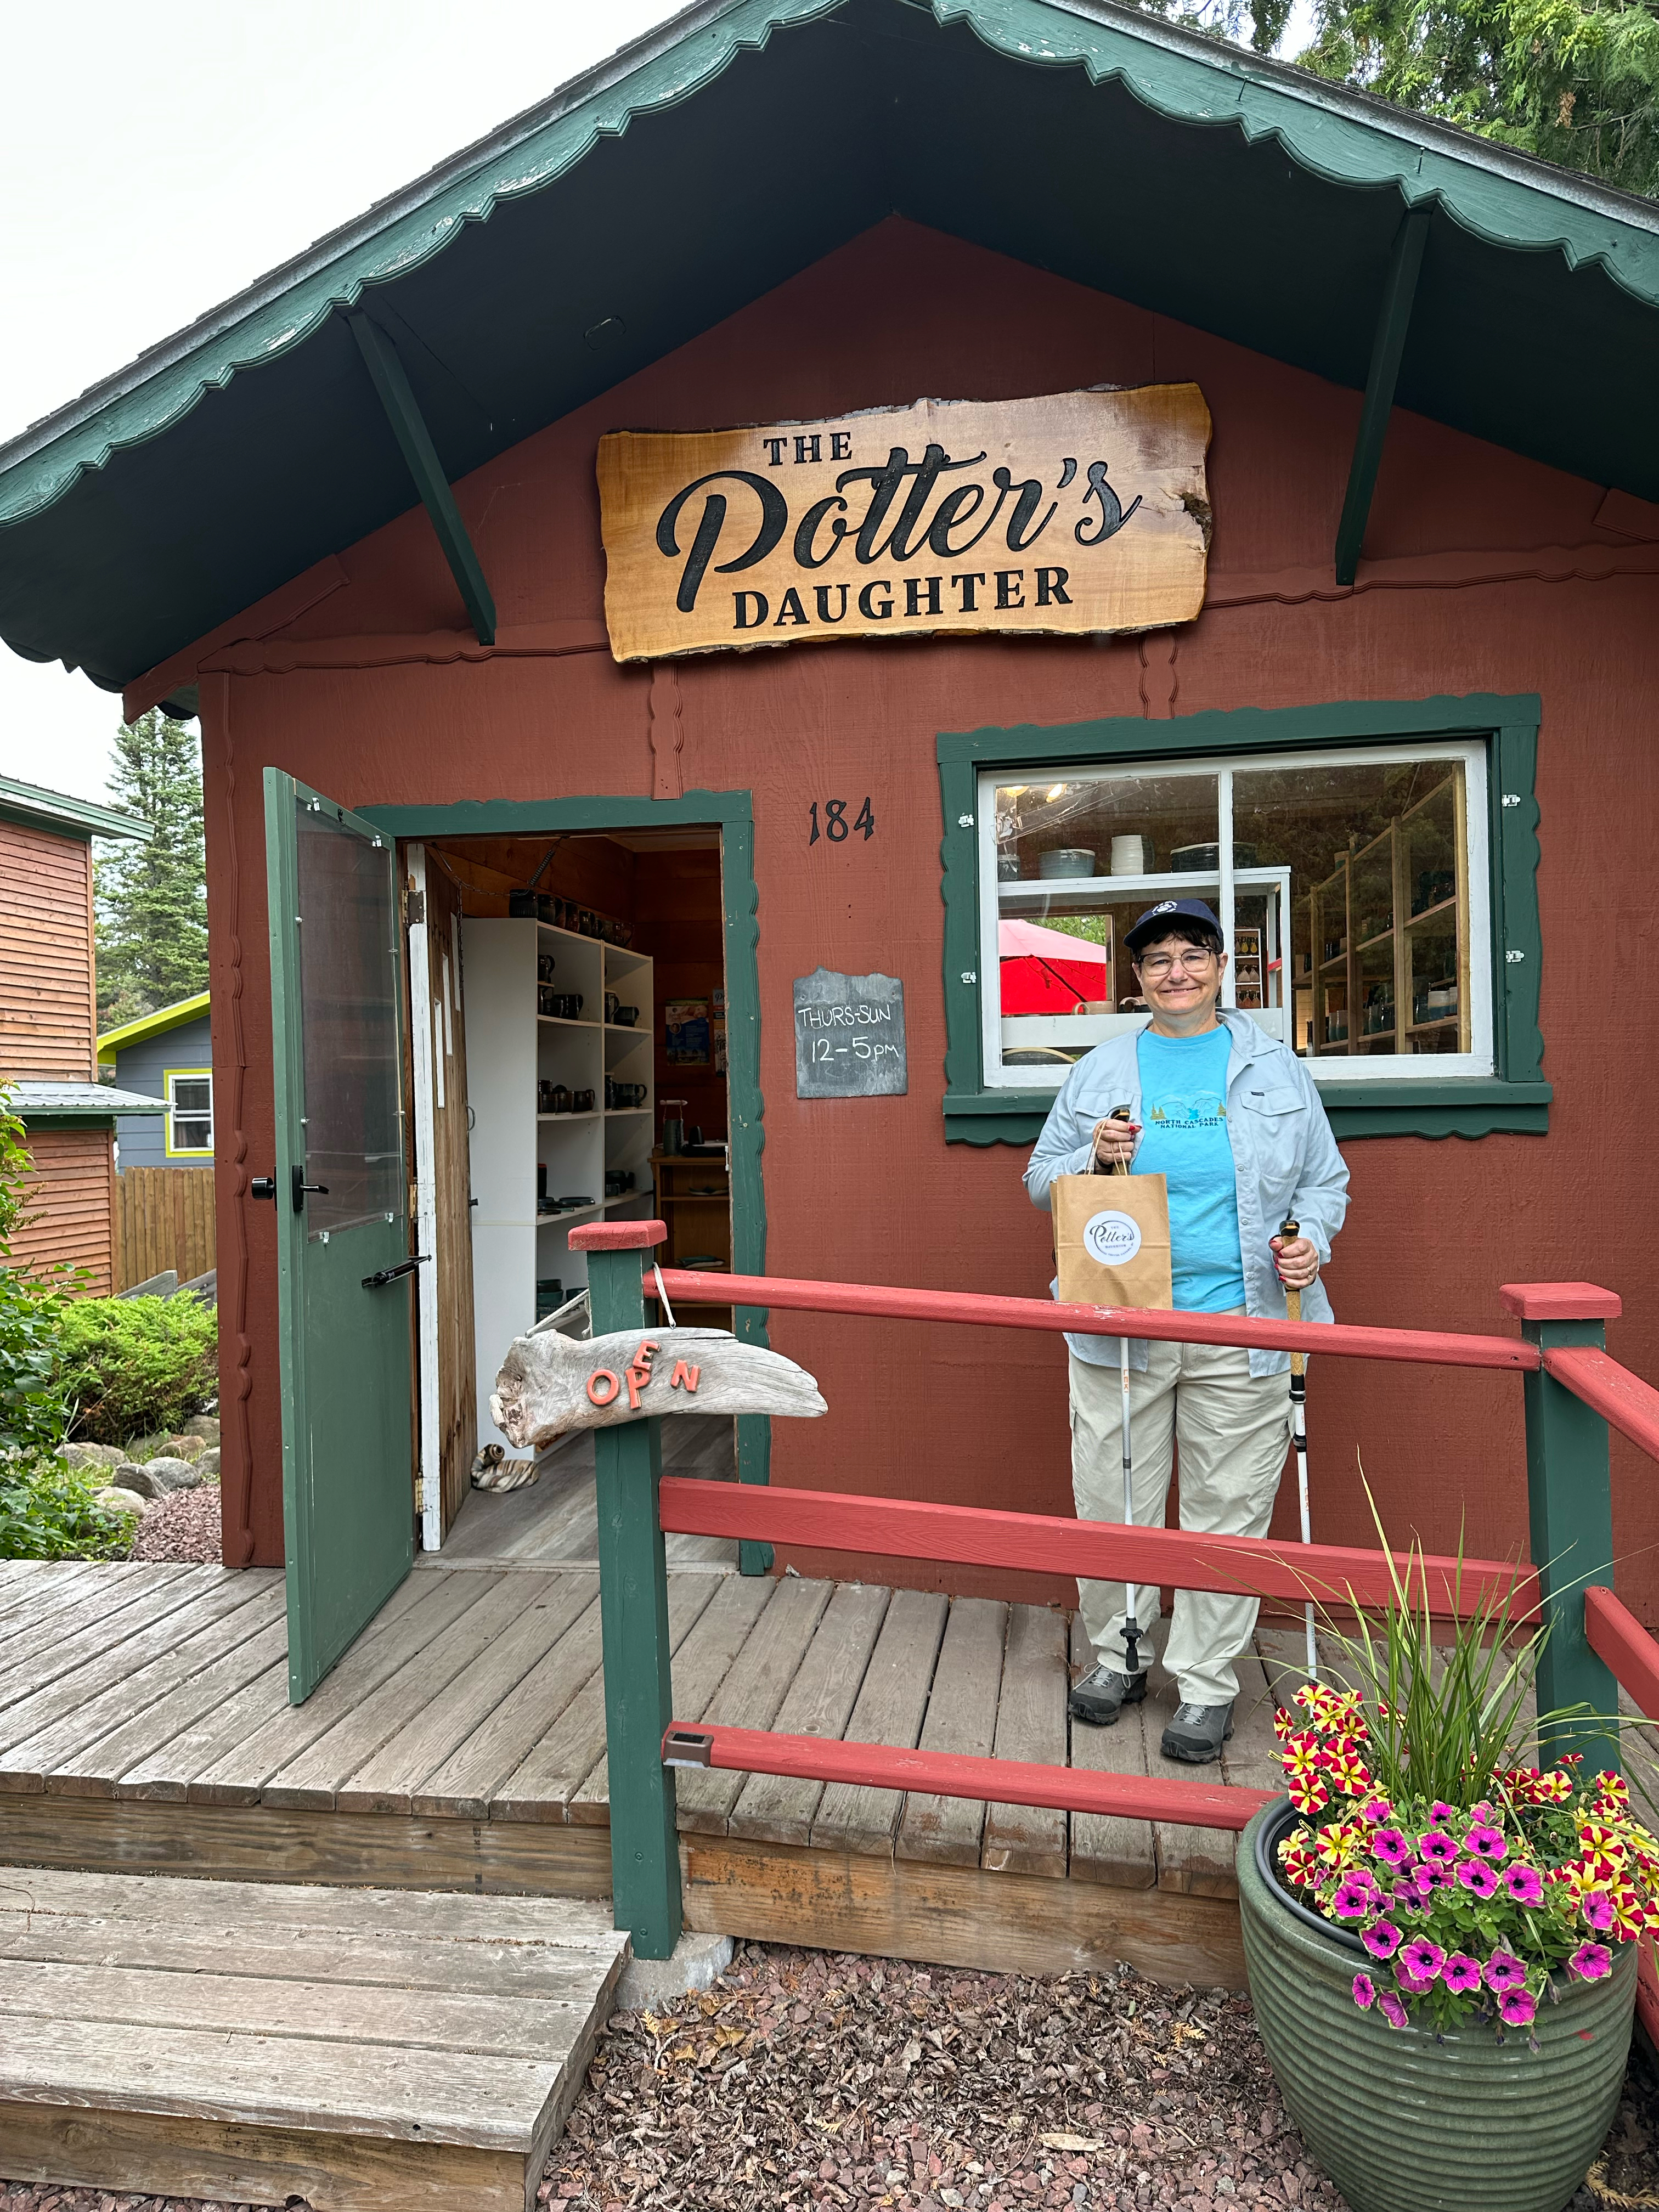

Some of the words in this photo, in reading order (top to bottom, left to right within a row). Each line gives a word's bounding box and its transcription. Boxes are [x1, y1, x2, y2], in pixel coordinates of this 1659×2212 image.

[763, 431, 853, 466] THE
[656, 443, 1143, 613] Potter's
[732, 566, 1074, 630] DAUGHTER
[809, 797, 874, 846] 184
[586, 1339, 701, 1409] OPEN
